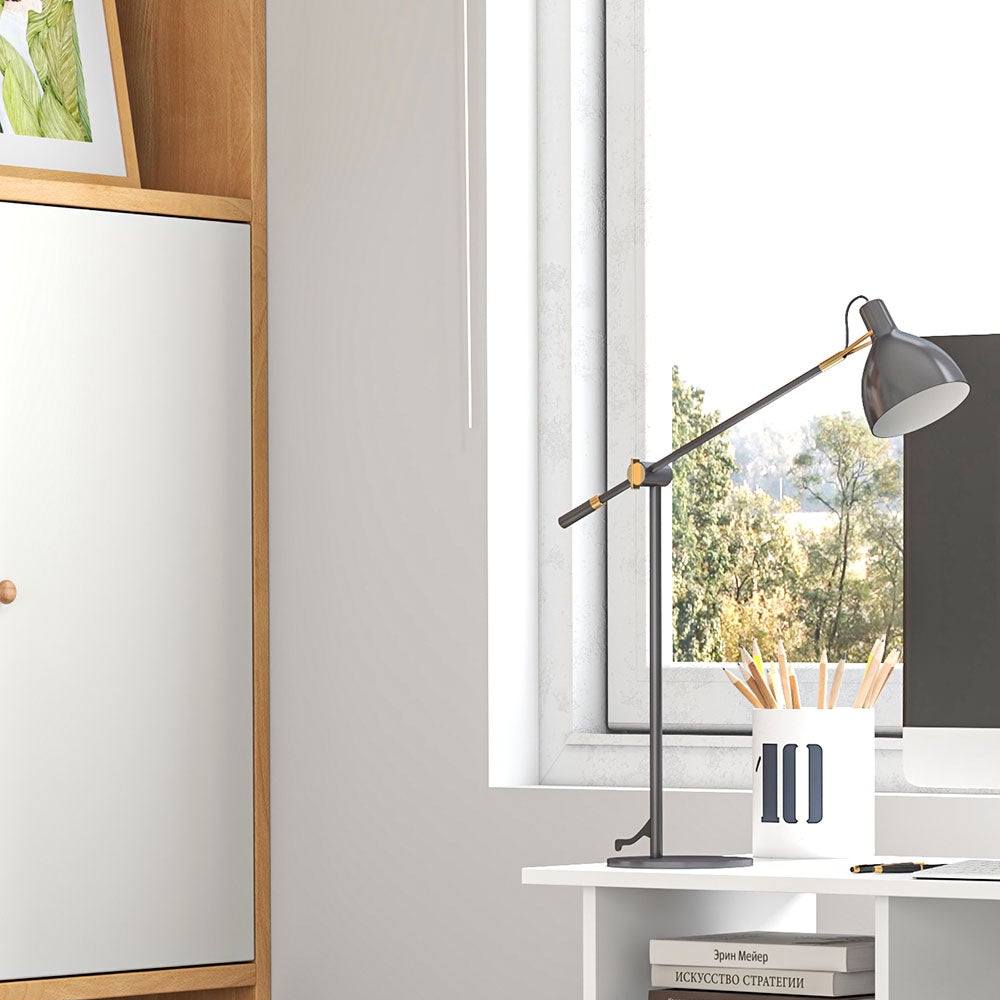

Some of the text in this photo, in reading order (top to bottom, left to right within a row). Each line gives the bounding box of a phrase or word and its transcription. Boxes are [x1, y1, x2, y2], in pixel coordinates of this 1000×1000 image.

[713, 949, 768, 964] Эрин Мейер
[675, 971, 805, 989] ИСКУССТВО СТРАТЕГИИ
